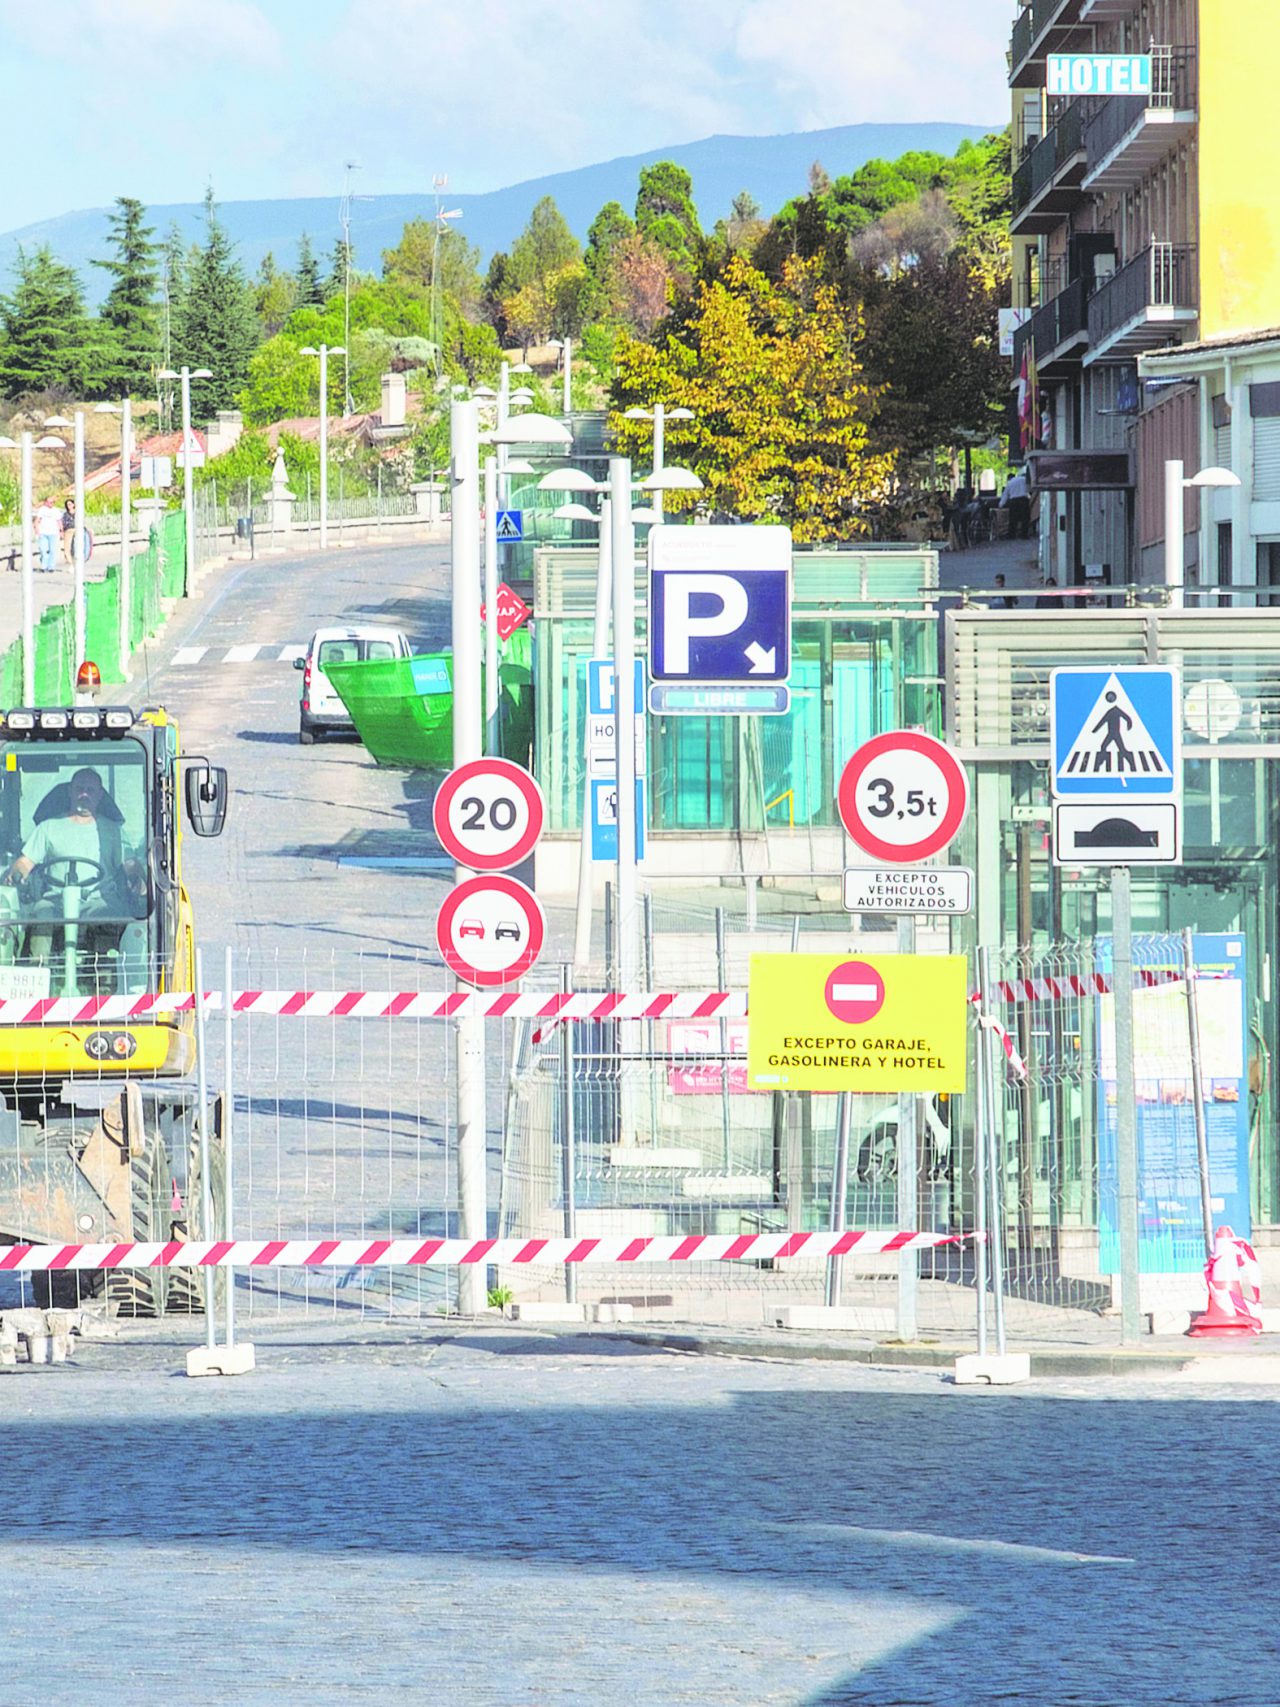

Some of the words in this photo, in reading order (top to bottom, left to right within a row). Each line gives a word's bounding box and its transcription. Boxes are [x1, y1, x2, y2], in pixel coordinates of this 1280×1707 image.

[1049, 59, 1148, 92] HOTEL
[663, 573, 749, 674] P
[692, 693, 747, 707] LIBRE
[867, 778, 937, 820] 3,5t
[460, 797, 517, 832] 20
[875, 873, 938, 884] EXCEPTO
[868, 885, 945, 896] VEHICULOS
[857, 897, 956, 908] AUTORIZADOS
[783, 1037, 857, 1050] EXCEPTO
[862, 1038, 931, 1052] GARAJE,
[768, 1055, 872, 1068] GASOLINERA
[878, 1056, 888, 1067] Y
[893, 1057, 946, 1069] HOTEL
